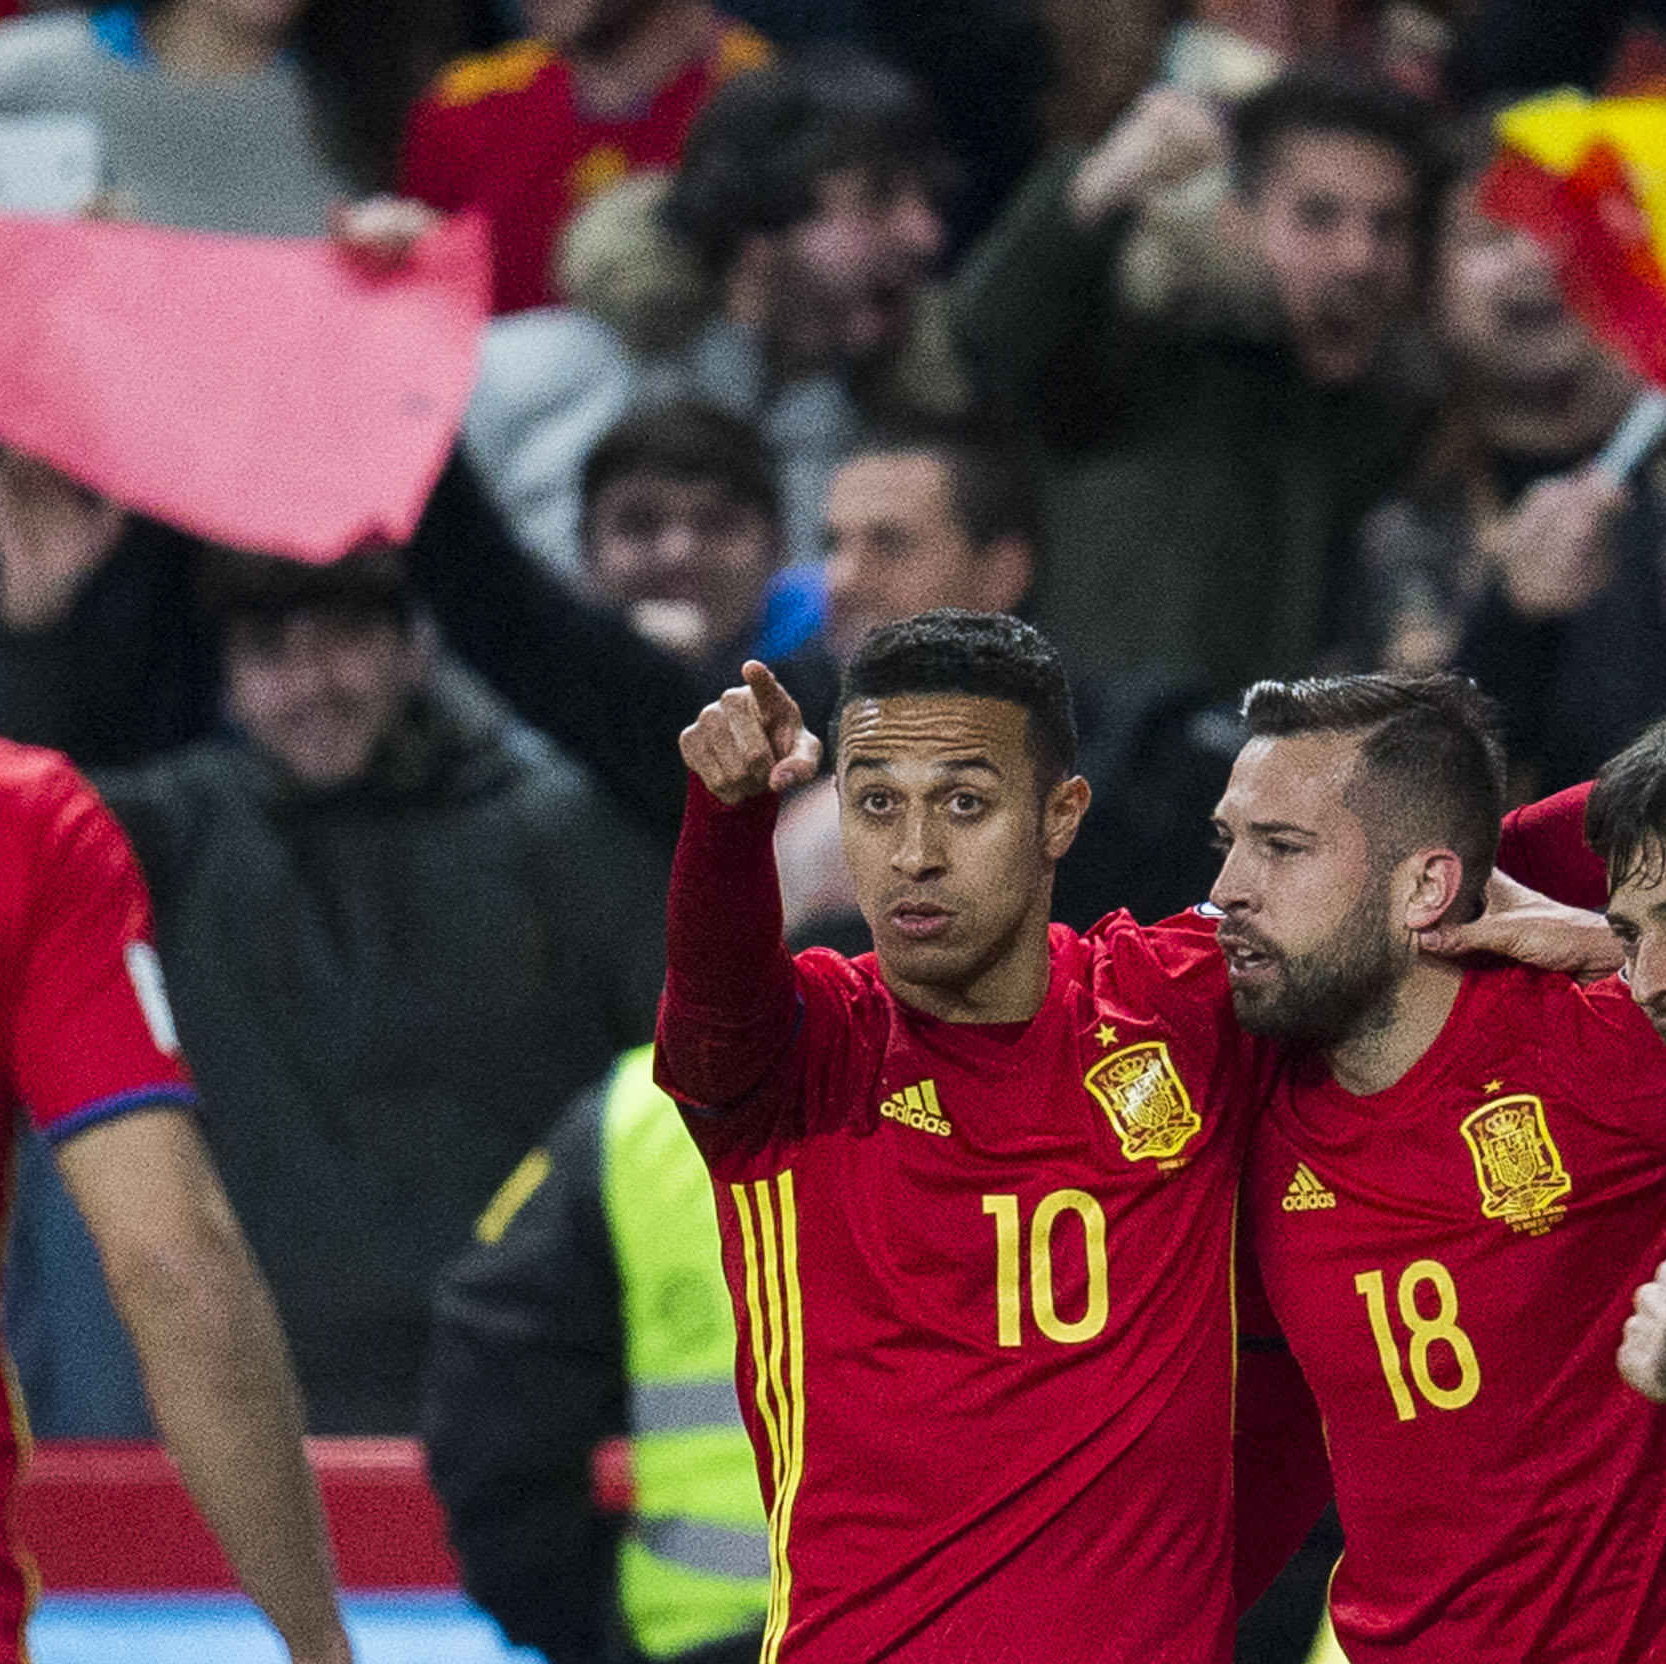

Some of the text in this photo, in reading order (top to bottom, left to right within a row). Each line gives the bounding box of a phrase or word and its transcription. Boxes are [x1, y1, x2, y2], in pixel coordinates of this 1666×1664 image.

[879, 1100, 952, 1137] adidas
[1281, 1191, 1336, 1212] adidas
[981, 1188, 1110, 1348] 10
[1354, 1258, 1482, 1423] 18
